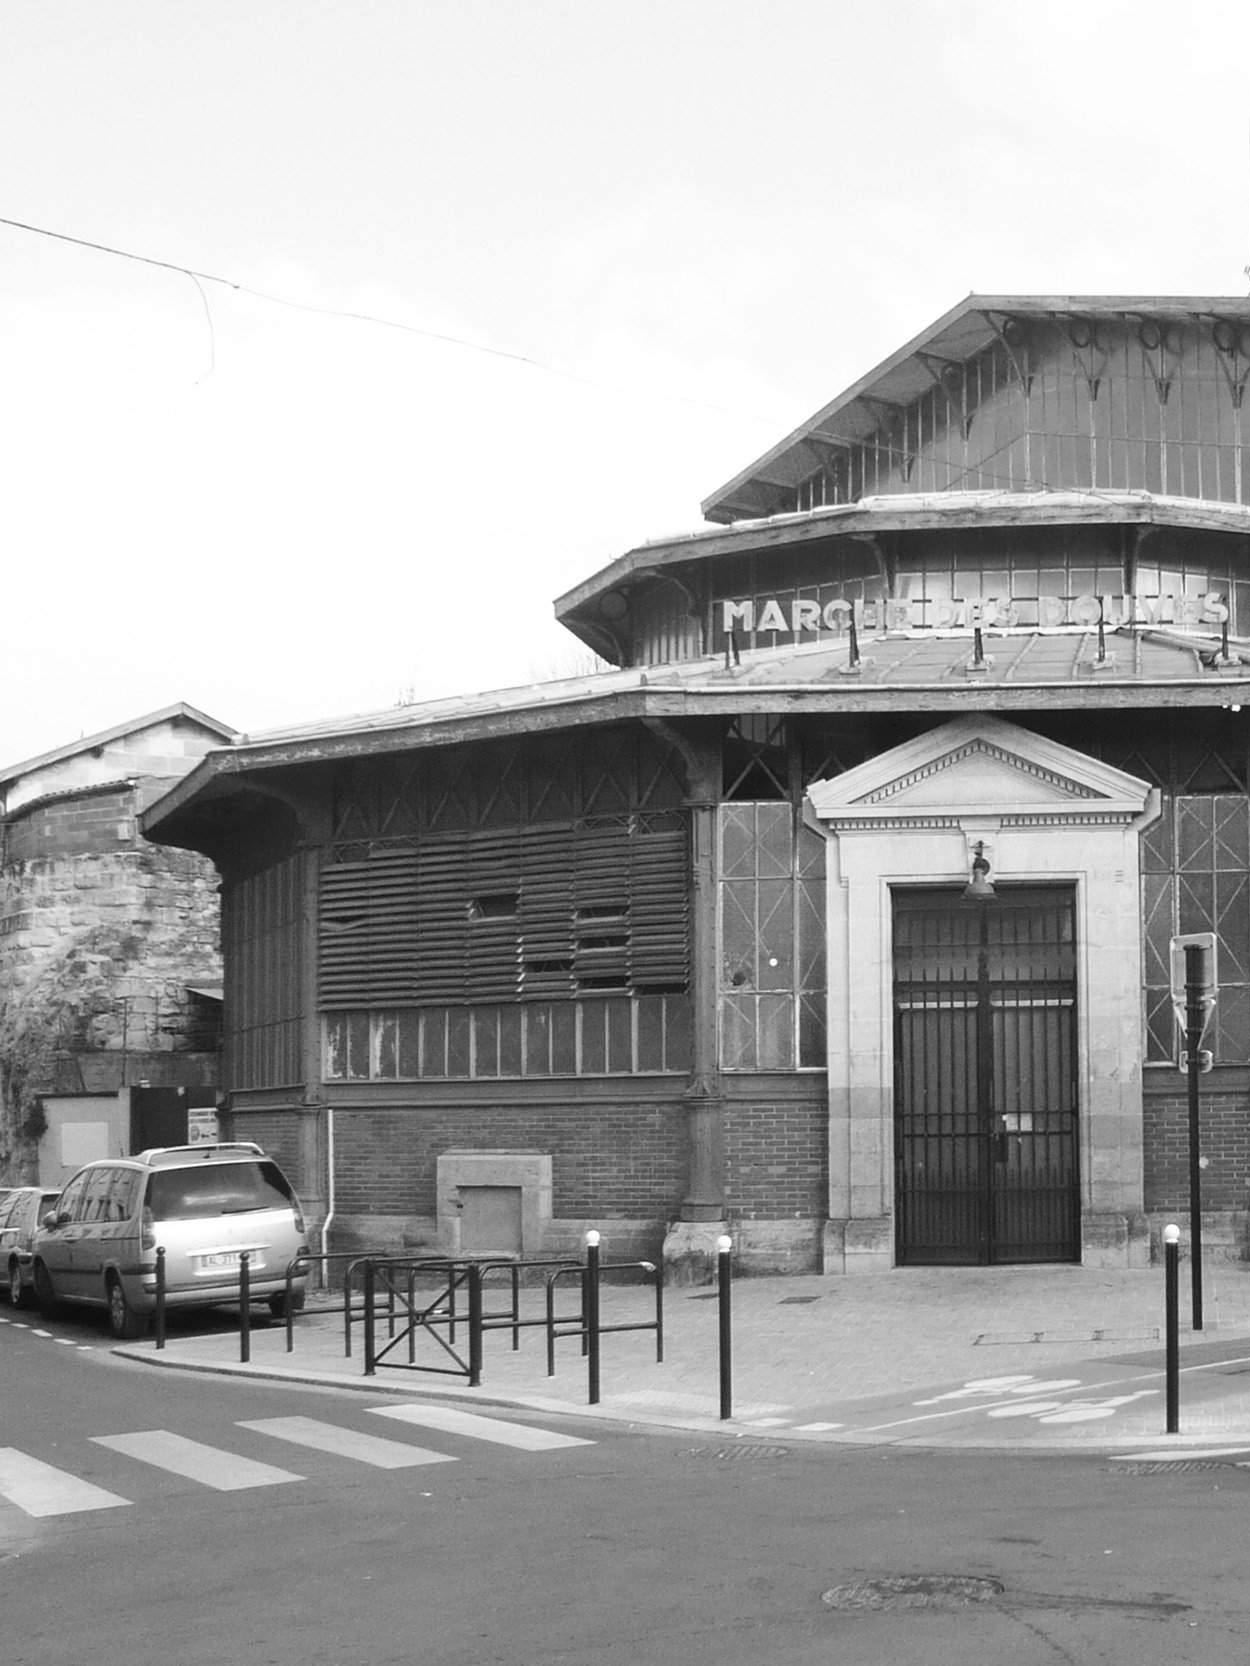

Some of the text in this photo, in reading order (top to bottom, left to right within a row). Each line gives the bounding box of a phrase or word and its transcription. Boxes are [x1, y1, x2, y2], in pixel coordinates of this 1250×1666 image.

[722, 593, 1228, 632] MARCHE DES DOUVES
